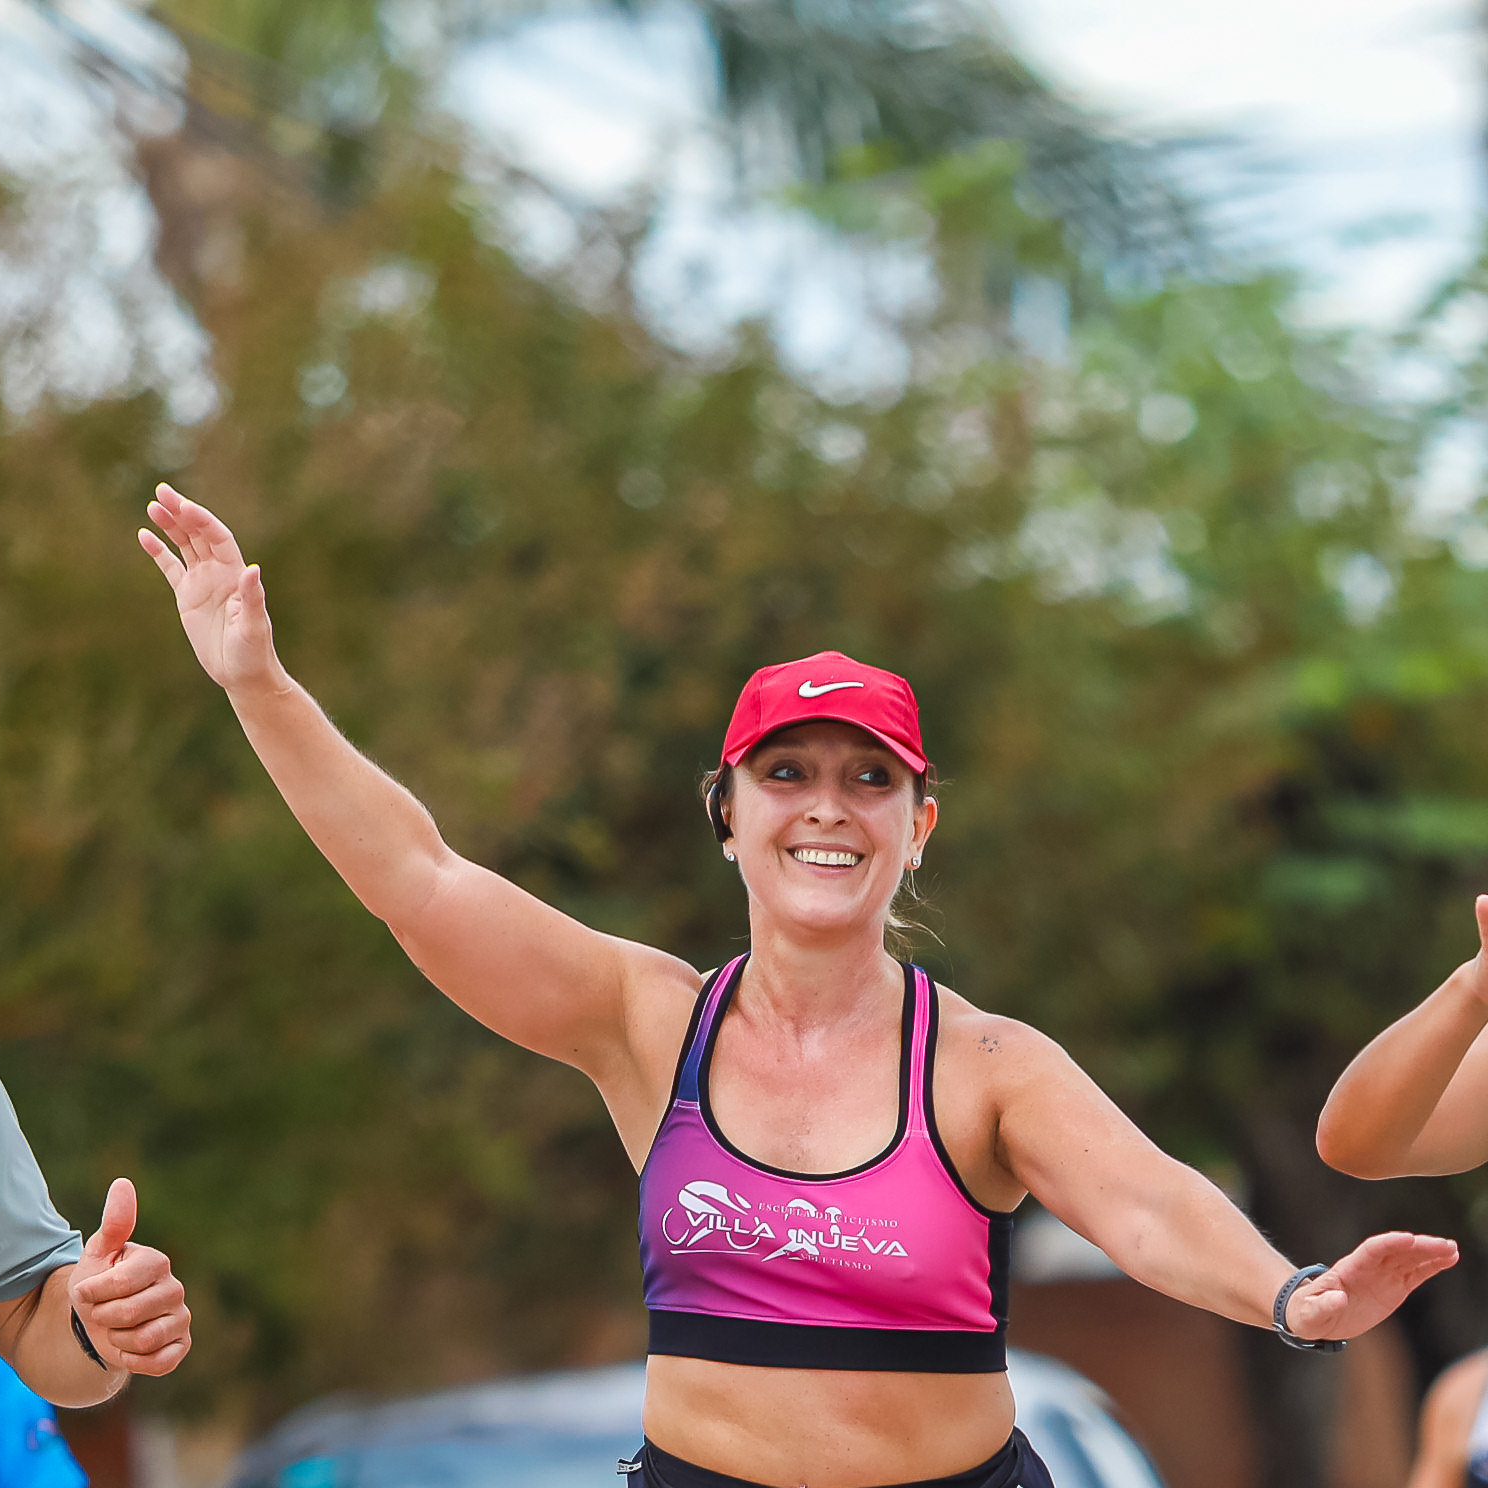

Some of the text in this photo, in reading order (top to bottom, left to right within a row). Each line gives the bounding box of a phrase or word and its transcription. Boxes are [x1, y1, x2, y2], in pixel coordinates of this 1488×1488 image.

[684, 1209, 909, 1257] VILLA NUEVA
[758, 1202, 899, 1228] ESCUELA DE CICLISMO
